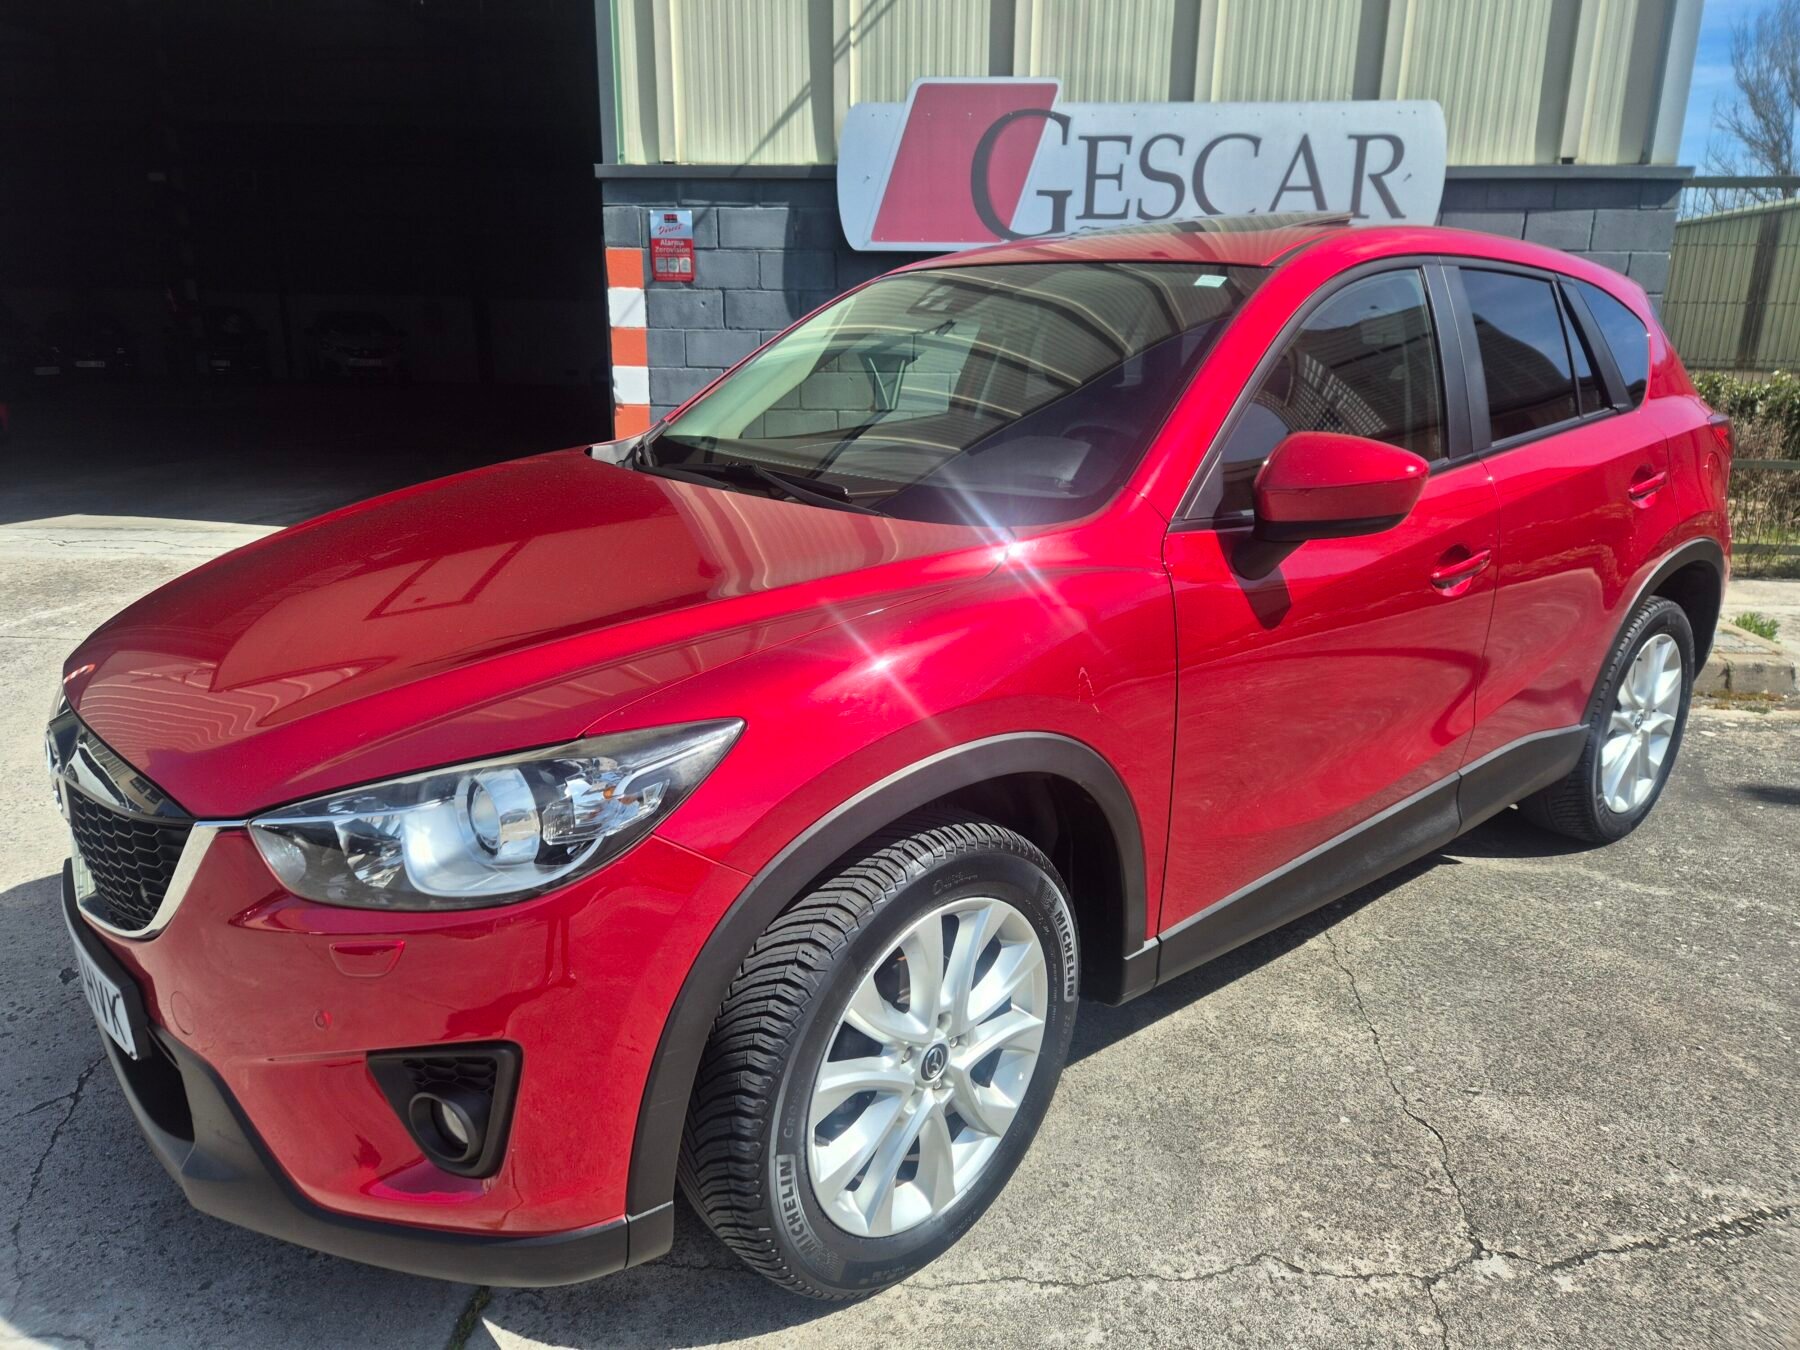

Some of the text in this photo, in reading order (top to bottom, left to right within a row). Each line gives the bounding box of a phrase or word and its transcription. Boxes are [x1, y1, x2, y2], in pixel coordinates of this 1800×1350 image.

[970, 108, 1406, 241] GESCAR
[1055, 910, 1075, 997] MICHELIN
[779, 1161, 818, 1257] MICHELIN
